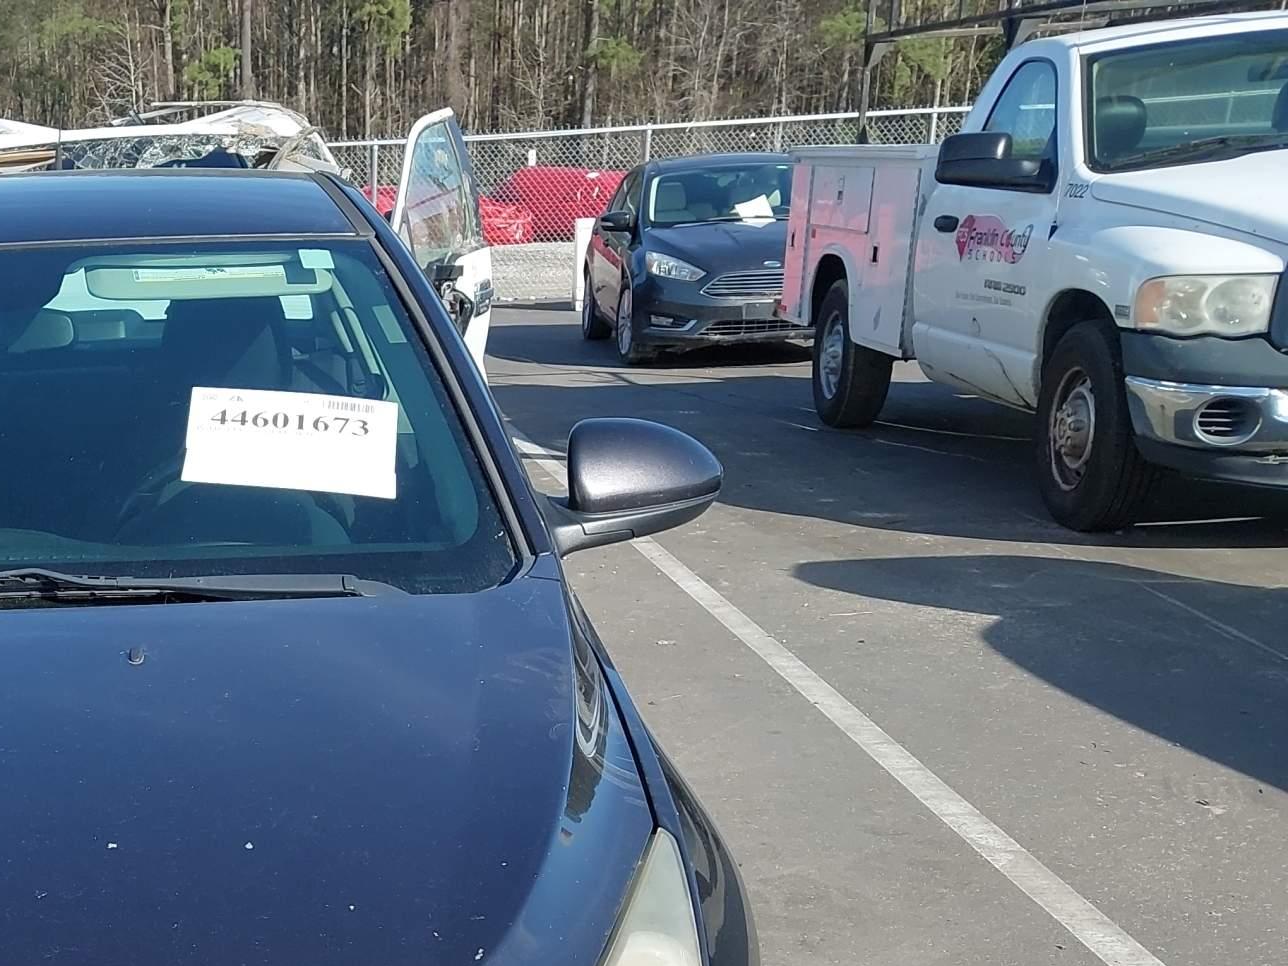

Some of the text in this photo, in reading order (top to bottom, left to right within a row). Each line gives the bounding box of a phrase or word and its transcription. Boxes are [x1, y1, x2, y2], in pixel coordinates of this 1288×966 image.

[1064, 183, 1089, 199] 7022
[969, 228, 999, 249] Franklin
[1000, 224, 1033, 254] County
[210, 408, 369, 437] 44601673
